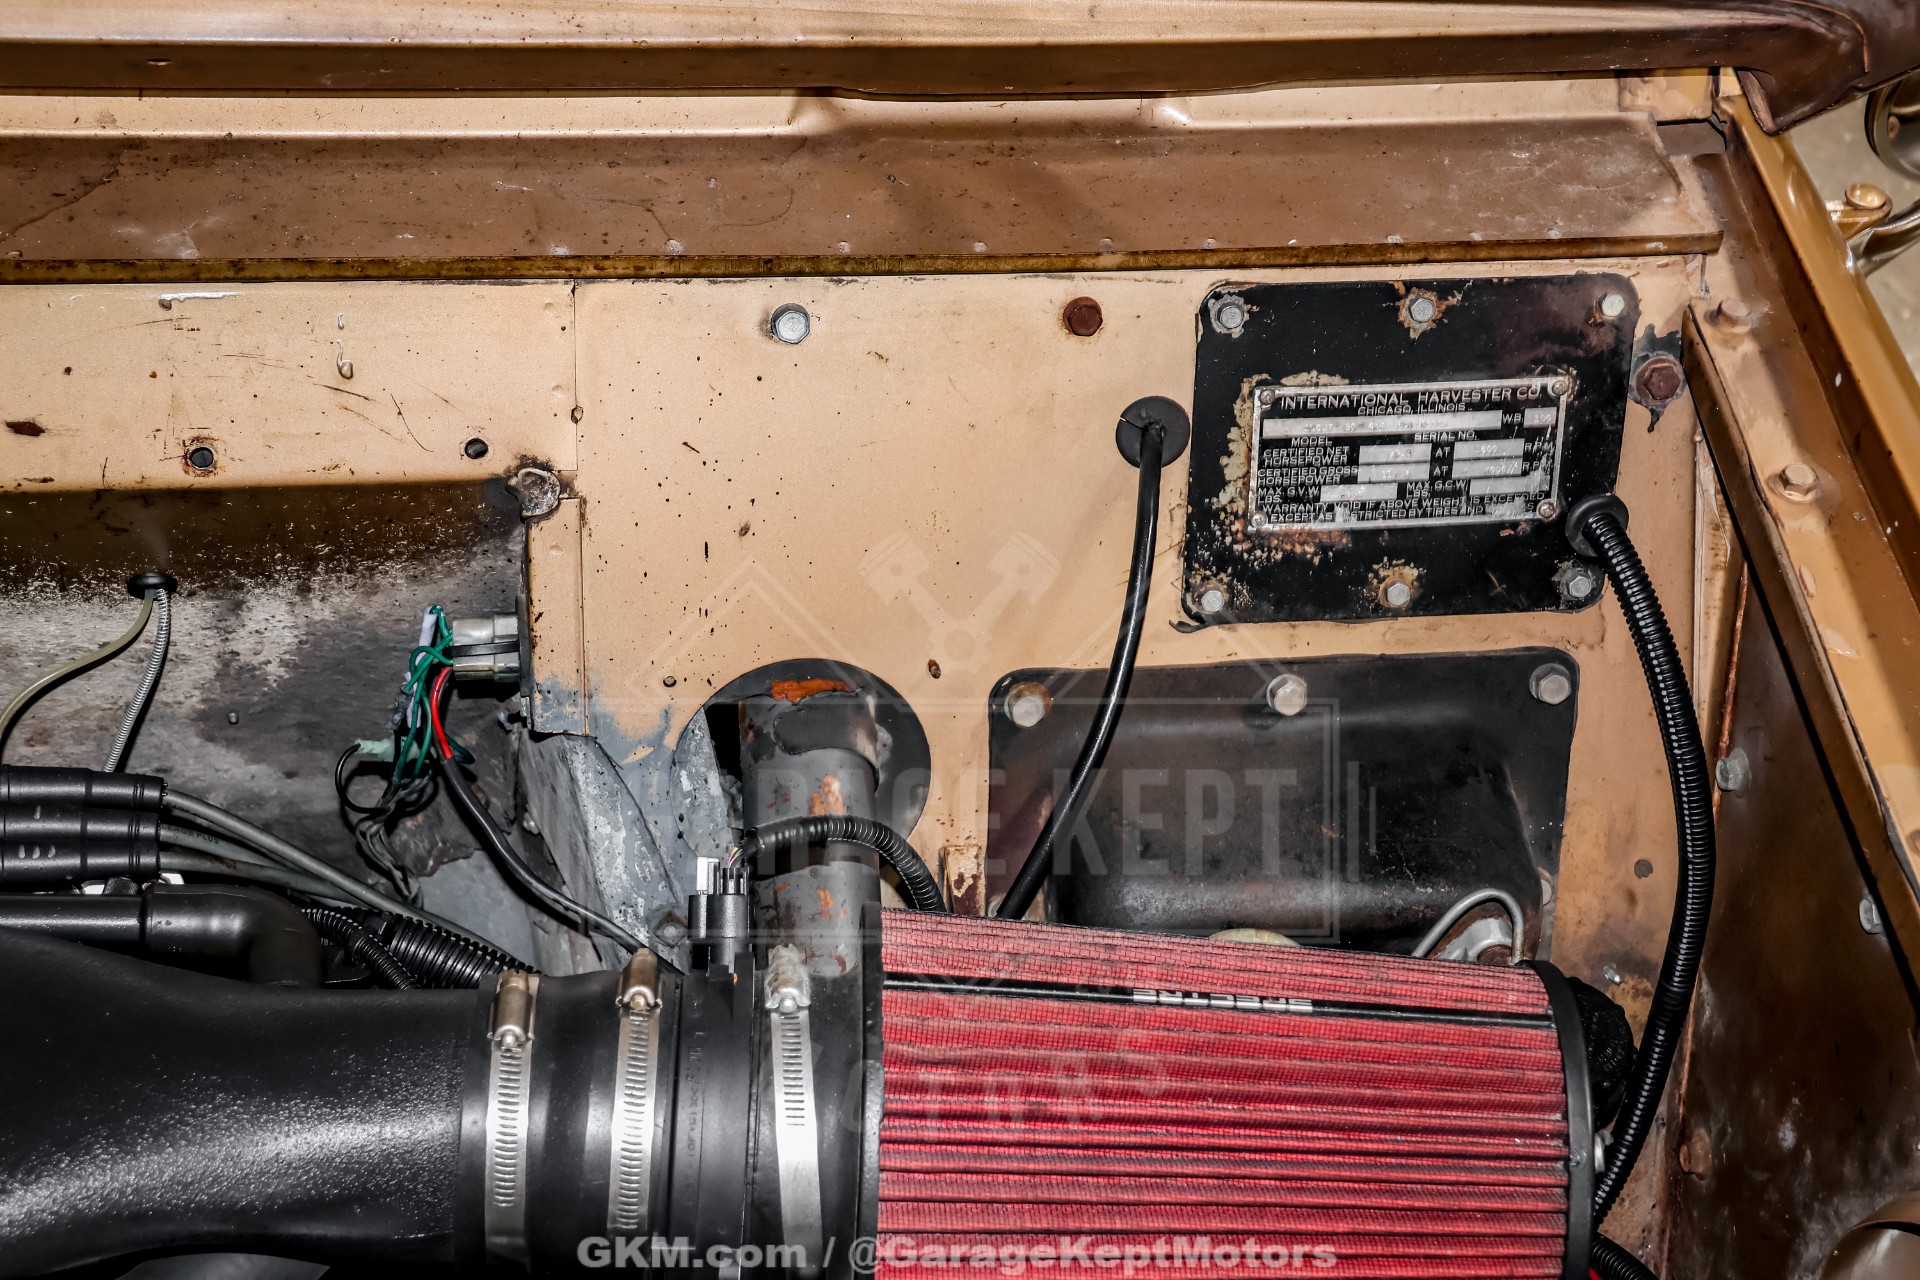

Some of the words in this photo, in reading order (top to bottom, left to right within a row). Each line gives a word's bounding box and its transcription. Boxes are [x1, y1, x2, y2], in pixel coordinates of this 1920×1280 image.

[1281, 393, 1409, 410] INTERNATIONAL
[1418, 388, 1512, 403] HARVESTER
[1417, 402, 1467, 414] ILLINOIS
[1502, 413, 1525, 425] W.B.
[1291, 436, 1333, 448] MODEL
[1414, 432, 1456, 443] SERIAL
[1457, 430, 1478, 441] NO.
[1263, 447, 1324, 459] CERTIFIED
[1326, 446, 1350, 457] NET
[1435, 446, 1451, 458] AT
[1264, 455, 1348, 467] HORSEPOWER
[1258, 466, 1317, 478] CERTIFIED
[1319, 465, 1358, 476] GROSS
[1433, 465, 1449, 476] AT
[1258, 475, 1341, 487] HORSEPOWER
[1406, 481, 1433, 492] MAX.
[1258, 486, 1285, 498] MAX.
[1406, 489, 1431, 500] LBS.
[1258, 495, 1283, 506] LBS.
[1263, 502, 1329, 514] WARRANTY
[1334, 501, 1361, 511] VOID
[1366, 500, 1376, 509] IF
[1380, 499, 1419, 509] ABOVE
[1422, 497, 1466, 508] WEIGHT
[1470, 495, 1480, 506] IS
[1271, 512, 1315, 523] EXCEPT
[1317, 511, 1333, 523] AS
[1409, 508, 1424, 518] BY
[1426, 506, 1458, 517] TIRES
